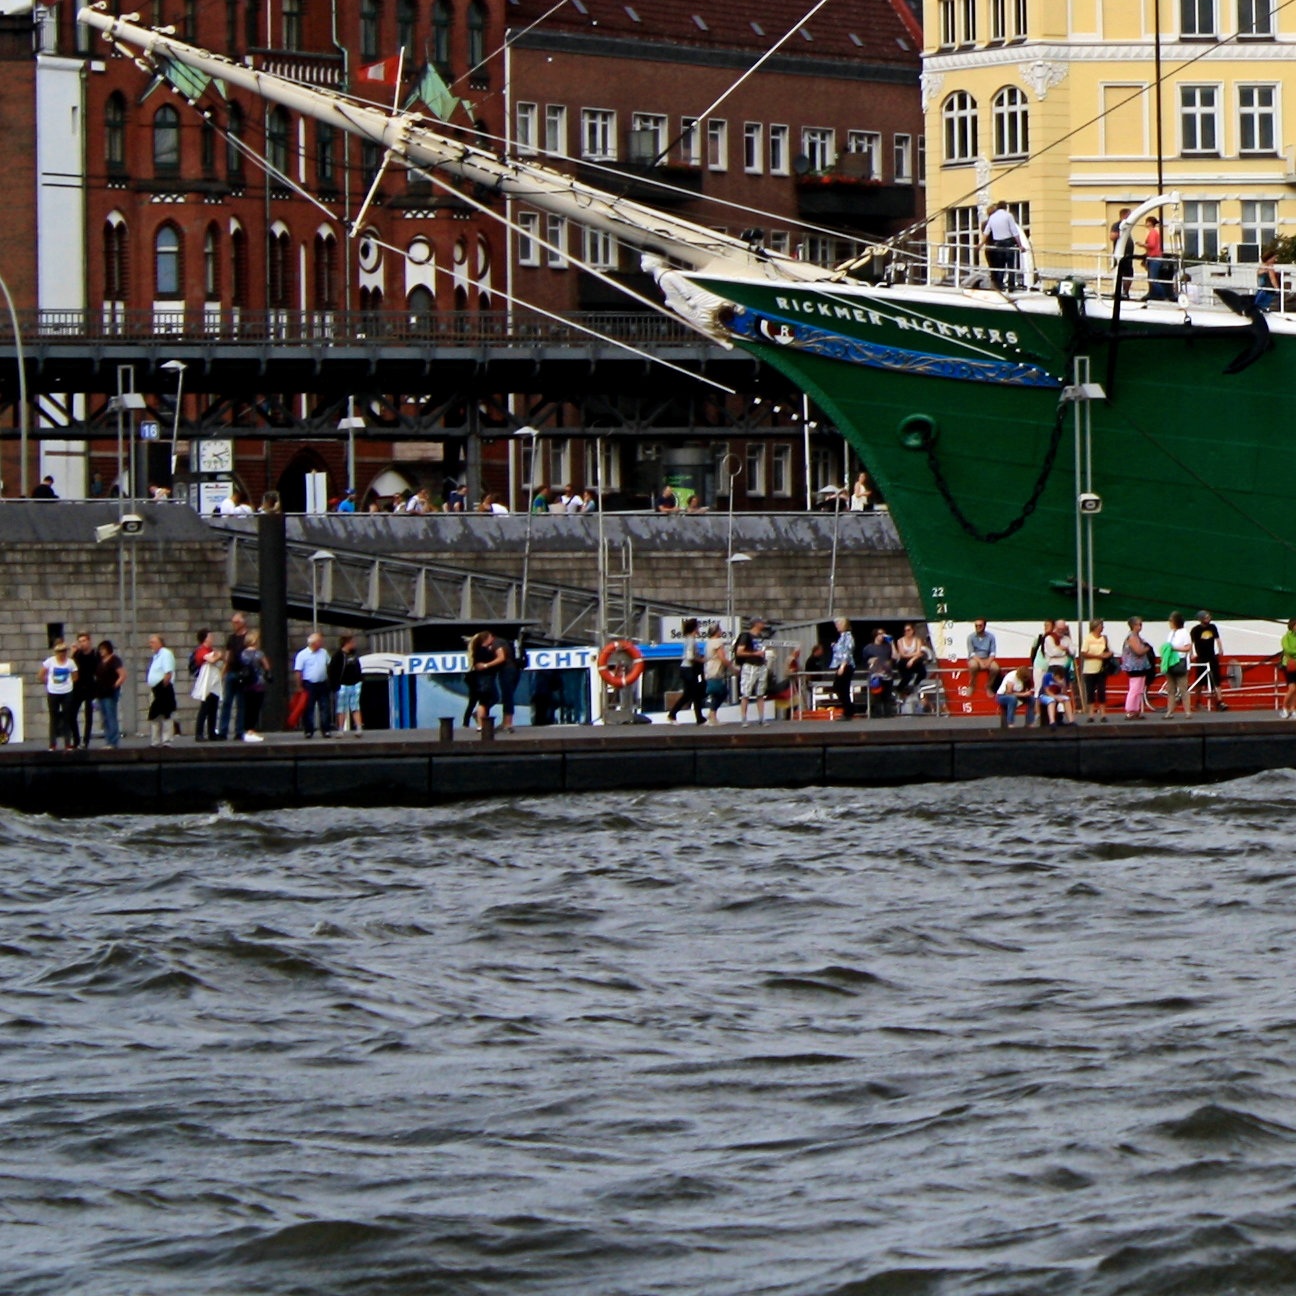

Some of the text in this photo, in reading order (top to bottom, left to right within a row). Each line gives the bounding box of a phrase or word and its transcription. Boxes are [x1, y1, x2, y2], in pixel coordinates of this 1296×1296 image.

[776, 296, 1018, 345] RICKMER RICKMERS
[780, 325, 789, 337] R
[932, 586, 945, 598] 22
[936, 603, 947, 614] 21
